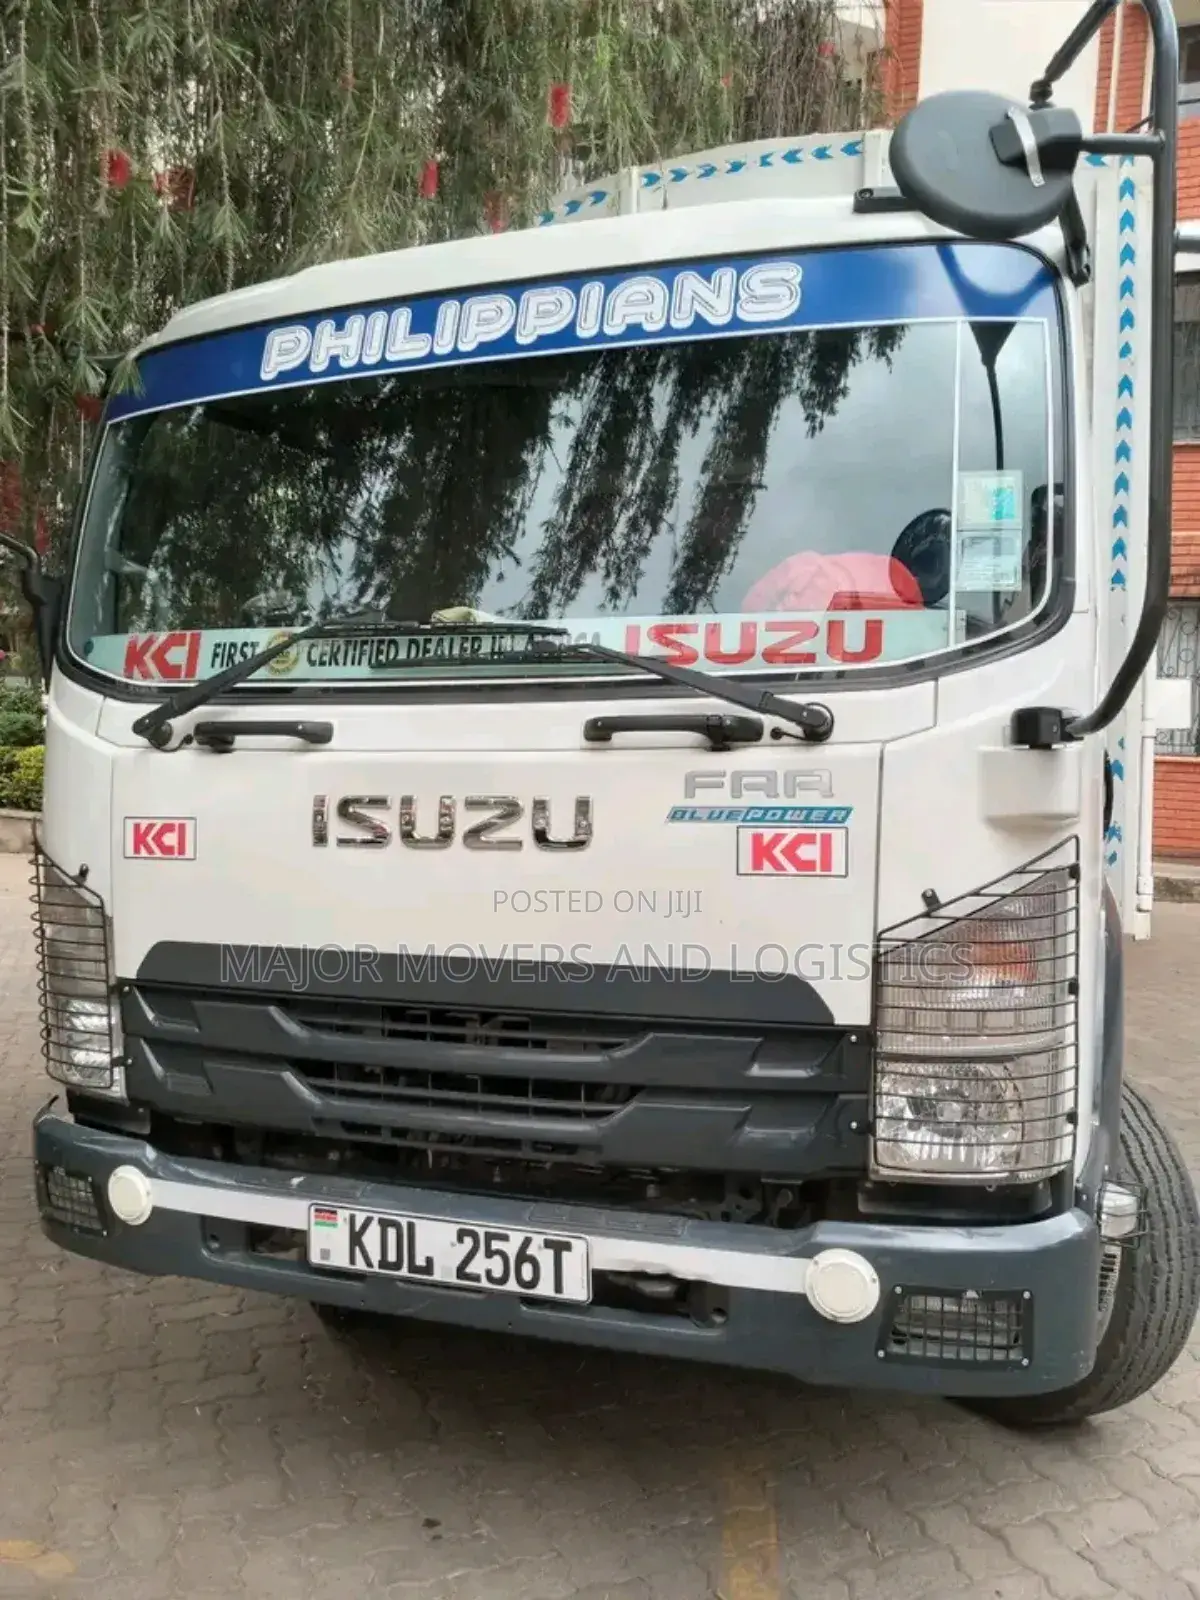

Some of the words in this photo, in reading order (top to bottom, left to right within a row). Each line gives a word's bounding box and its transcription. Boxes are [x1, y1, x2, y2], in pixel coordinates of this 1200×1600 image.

[260, 262, 803, 381] PHILIPPIANS
[123, 632, 201, 679] KCI
[210, 641, 259, 670] FIRST
[306, 637, 398, 668] CERTIFIED
[406, 637, 482, 660] DEALER
[624, 619, 883, 667] ISUZU
[132, 822, 187, 856] KCI
[312, 794, 594, 851] ISUZU
[751, 833, 832, 872] KCI
[350, 1213, 434, 1277] KDL
[456, 1228, 573, 1295] 256T
